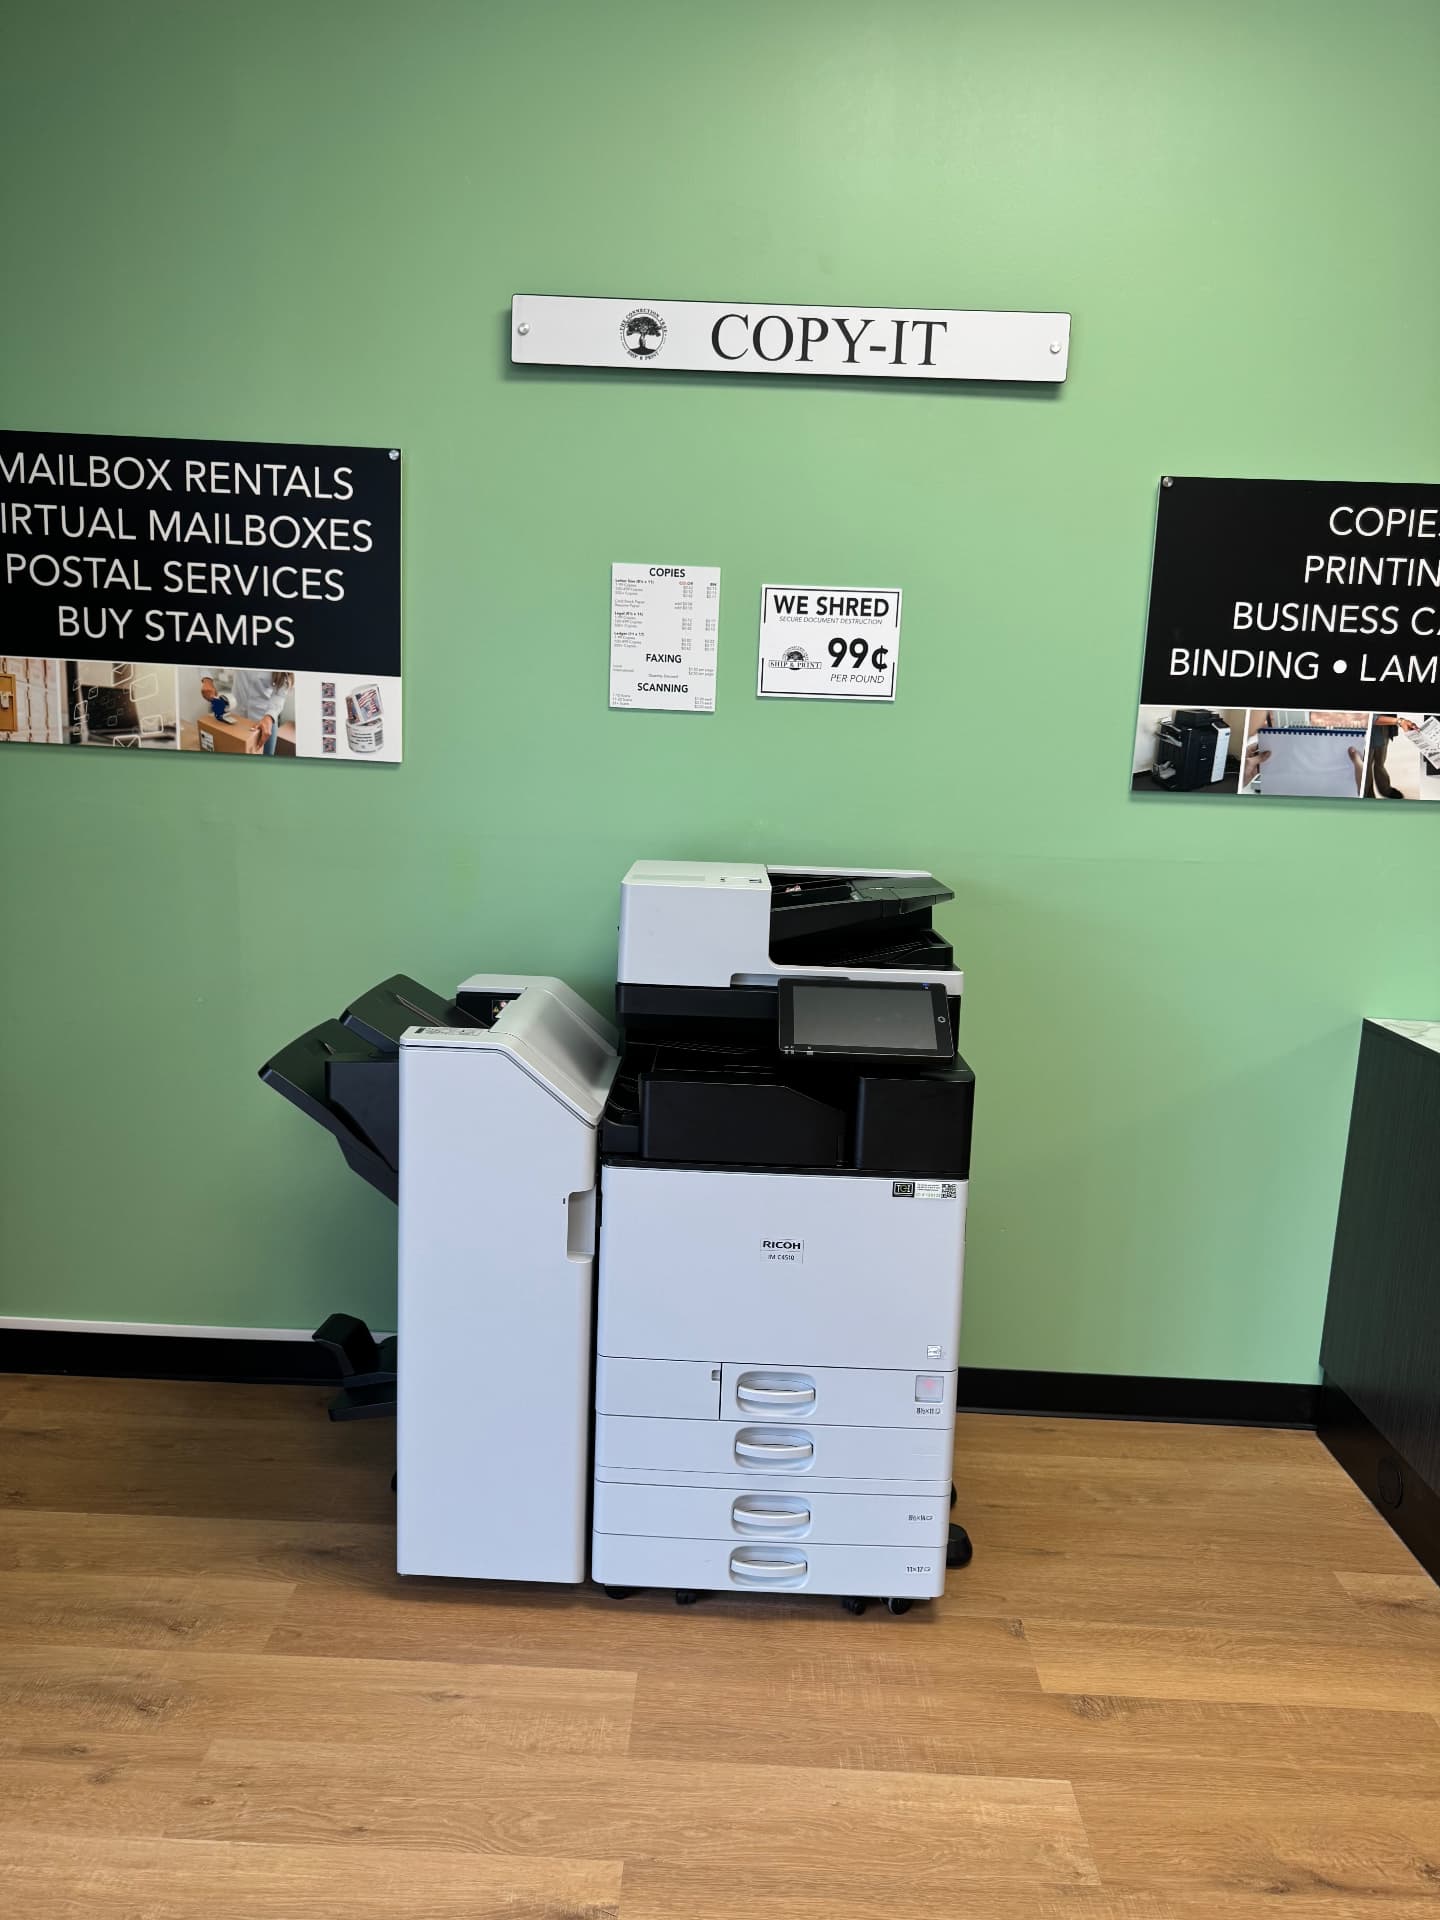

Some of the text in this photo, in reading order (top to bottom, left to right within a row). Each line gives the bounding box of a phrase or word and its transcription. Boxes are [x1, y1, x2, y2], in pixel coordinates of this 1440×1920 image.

[711, 314, 947, 366] COPY-IT
[0, 453, 353, 500] MAILBOX RENTALS
[1, 503, 373, 552] IRTUAL MAILBOXES
[1330, 507, 1440, 537] COPIE
[7, 554, 344, 601] POSTAL SERVICES
[650, 567, 686, 577] COPIES
[1305, 556, 1440, 587] PRINTIN
[774, 595, 889, 616] WE SHRED
[1234, 602, 1440, 635] BUSINESS C
[59, 606, 294, 648] BUY STAMPS
[646, 653, 682, 663] FAXING
[828, 637, 889, 672] 99¢
[1170, 648, 1437, 683] BINDING LAM
[637, 683, 689, 693] SCANNING
[830, 673, 885, 684] PER POUND
[763, 1240, 801, 1250] RICOH
